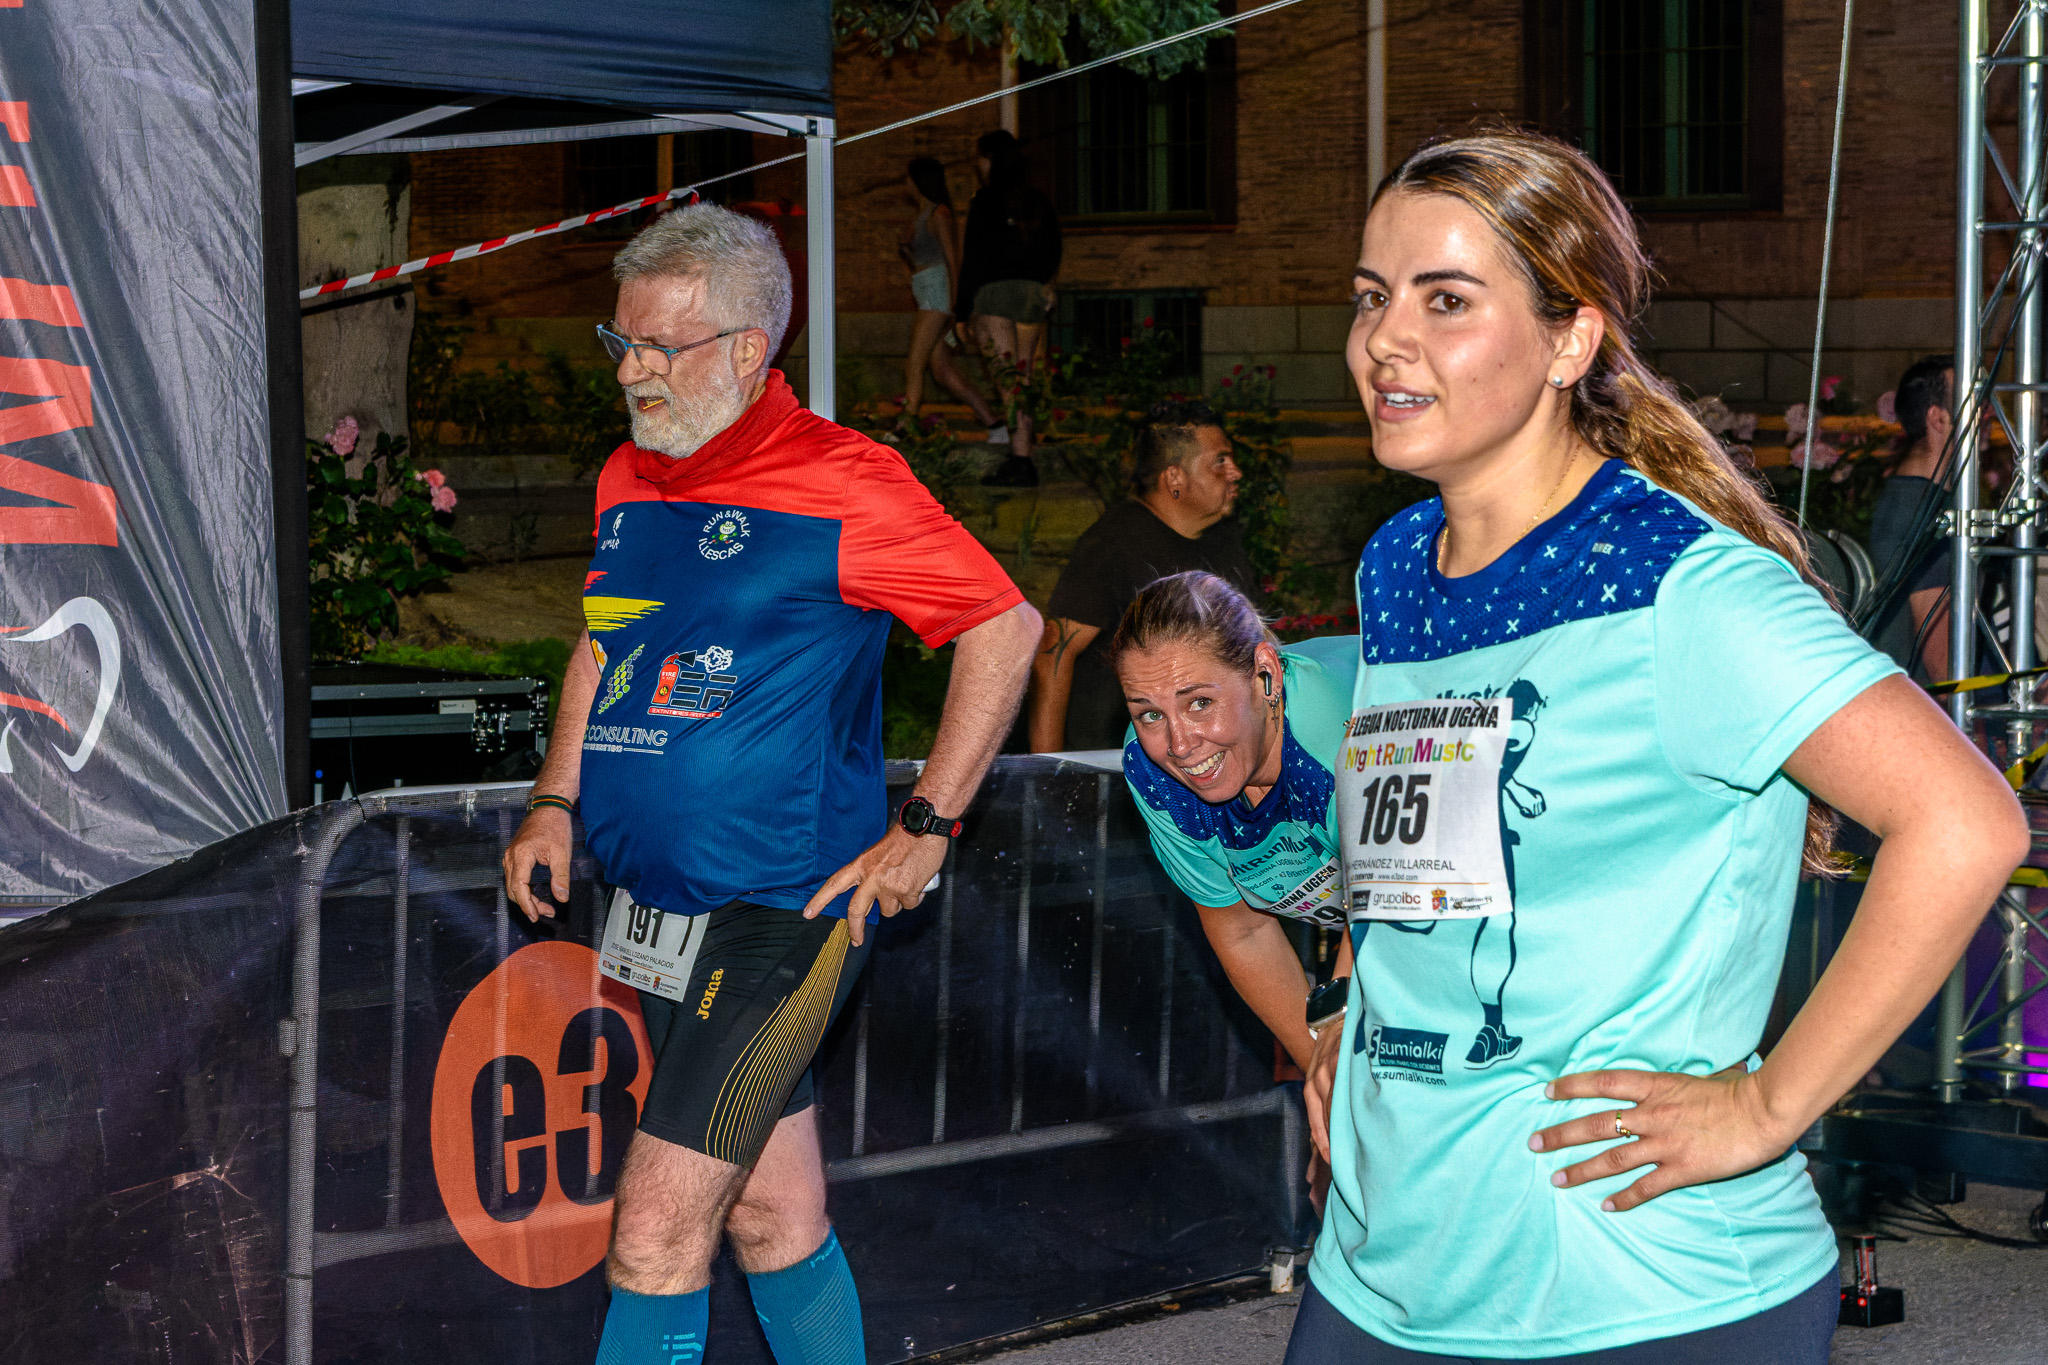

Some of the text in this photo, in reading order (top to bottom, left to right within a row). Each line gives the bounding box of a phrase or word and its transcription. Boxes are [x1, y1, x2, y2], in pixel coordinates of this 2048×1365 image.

[699, 537, 744, 560] ILLESCAS
[1352, 705, 1499, 737] LEGUA NOCTURNA UGENA
[588, 724, 668, 746] CONSULTING
[1359, 773, 1432, 845] 165
[1239, 863, 1277, 883] NOCTURNA
[1393, 859, 1456, 871] VILLARREAL
[1302, 864, 1338, 893] UGENA
[1373, 891, 1421, 906] grupoibc
[625, 903, 664, 948] 191
[631, 951, 650, 962] LOZANO
[649, 956, 675, 970] PALACIOS
[1380, 1040, 1444, 1060] sumialki
[471, 1006, 640, 1224] e3
